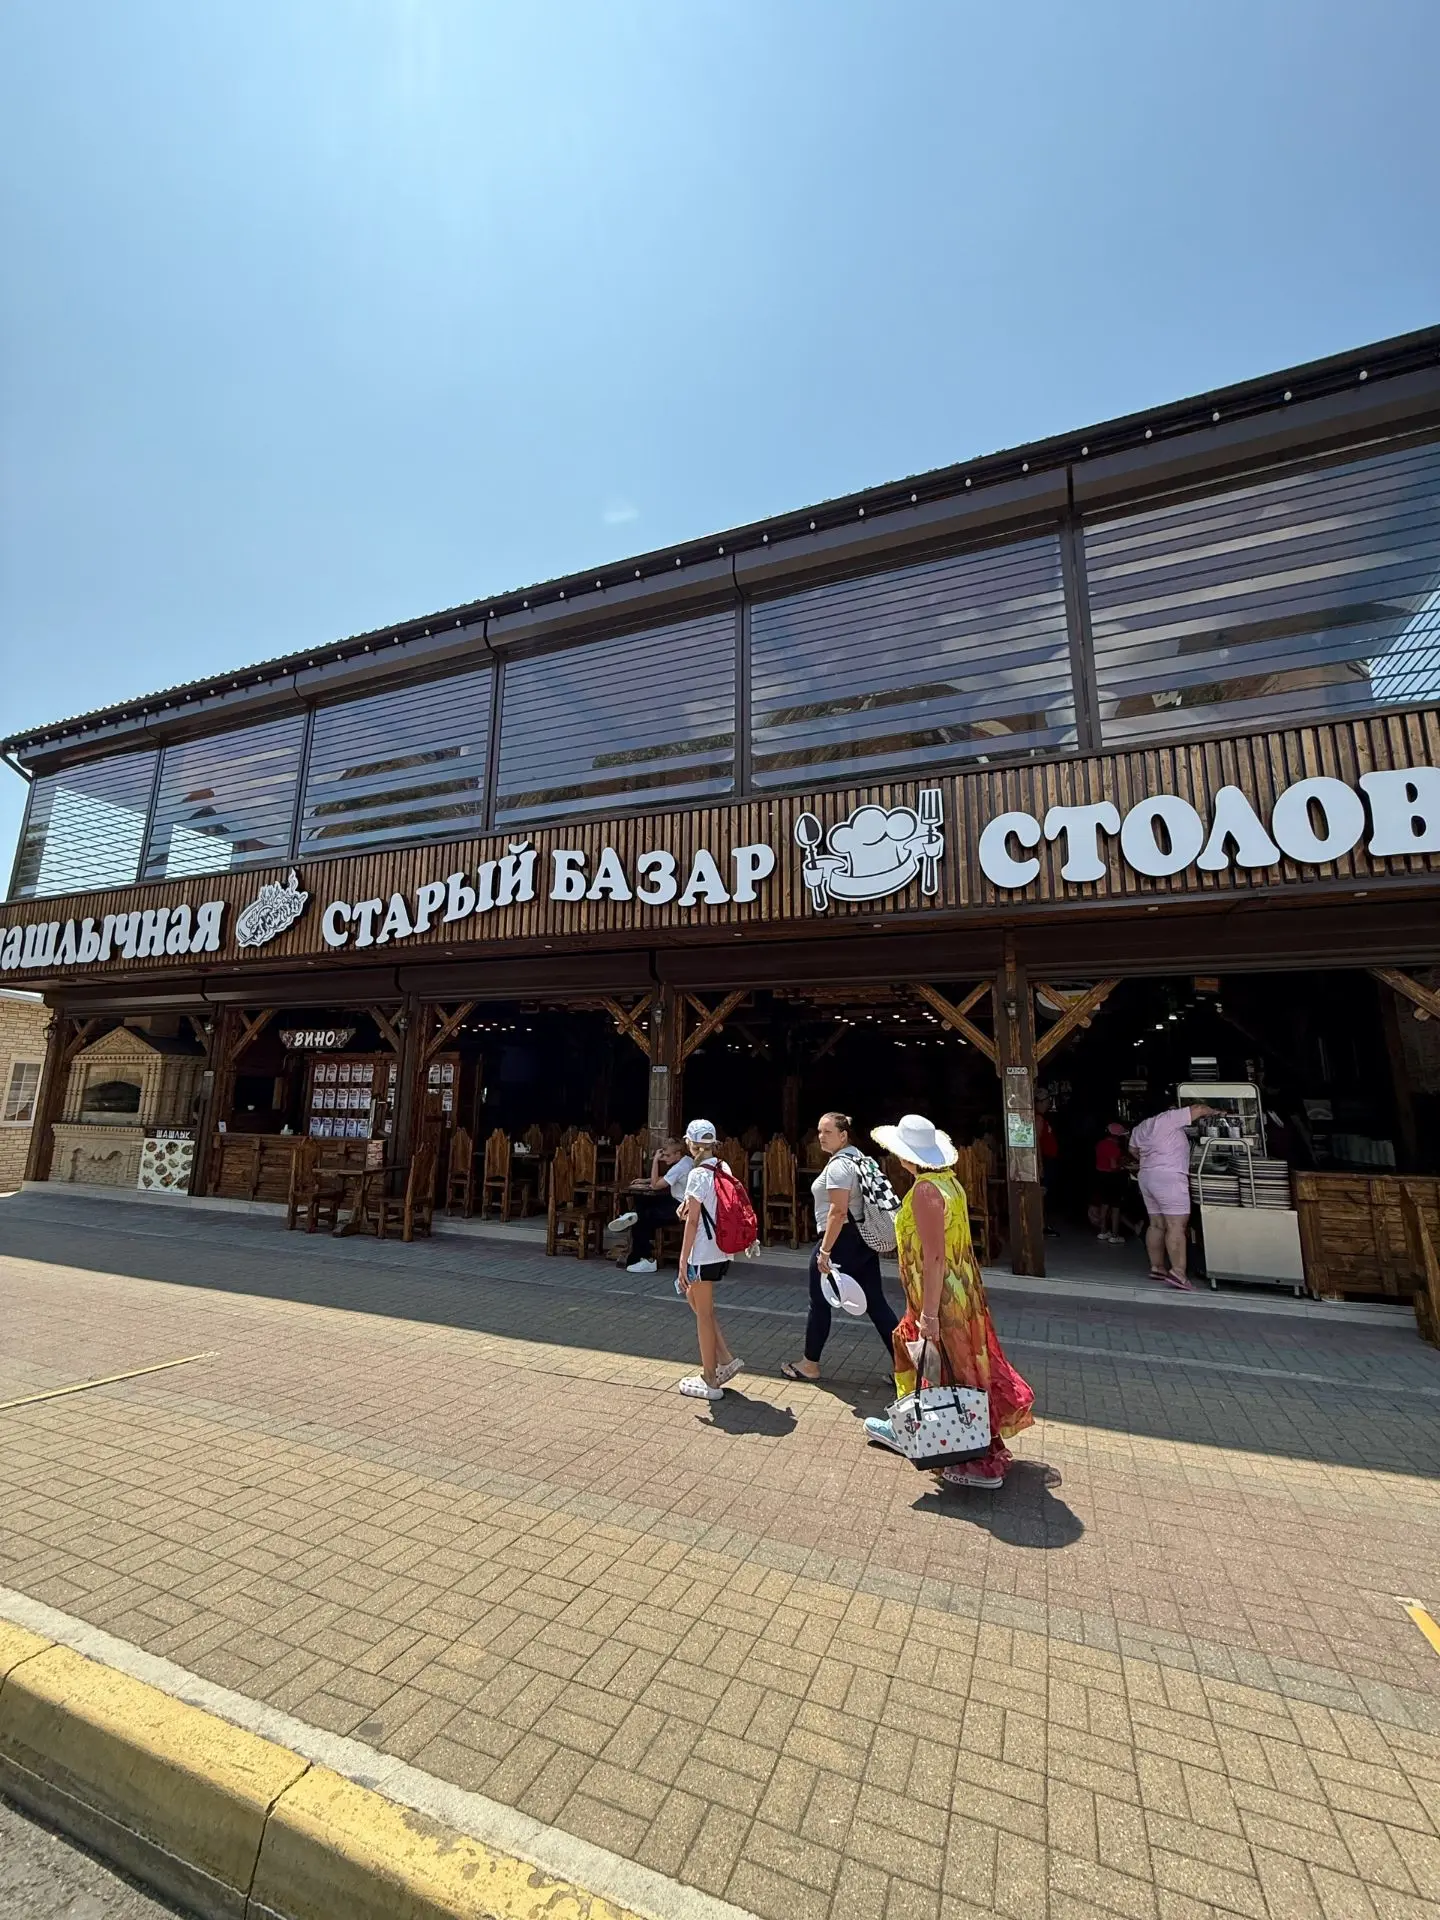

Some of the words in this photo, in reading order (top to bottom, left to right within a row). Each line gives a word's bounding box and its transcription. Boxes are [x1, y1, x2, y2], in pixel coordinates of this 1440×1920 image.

[978, 766, 1440, 888] СТОЛОВ
[322, 840, 537, 947] СТАРЫЙ
[550, 843, 775, 906] БАЗАР
[0, 900, 225, 971] ашлычная
[293, 1030, 336, 1047] ВИНО
[155, 1129, 191, 1140] ШАШЛЫК
[944, 1473, 970, 1484] crocs
